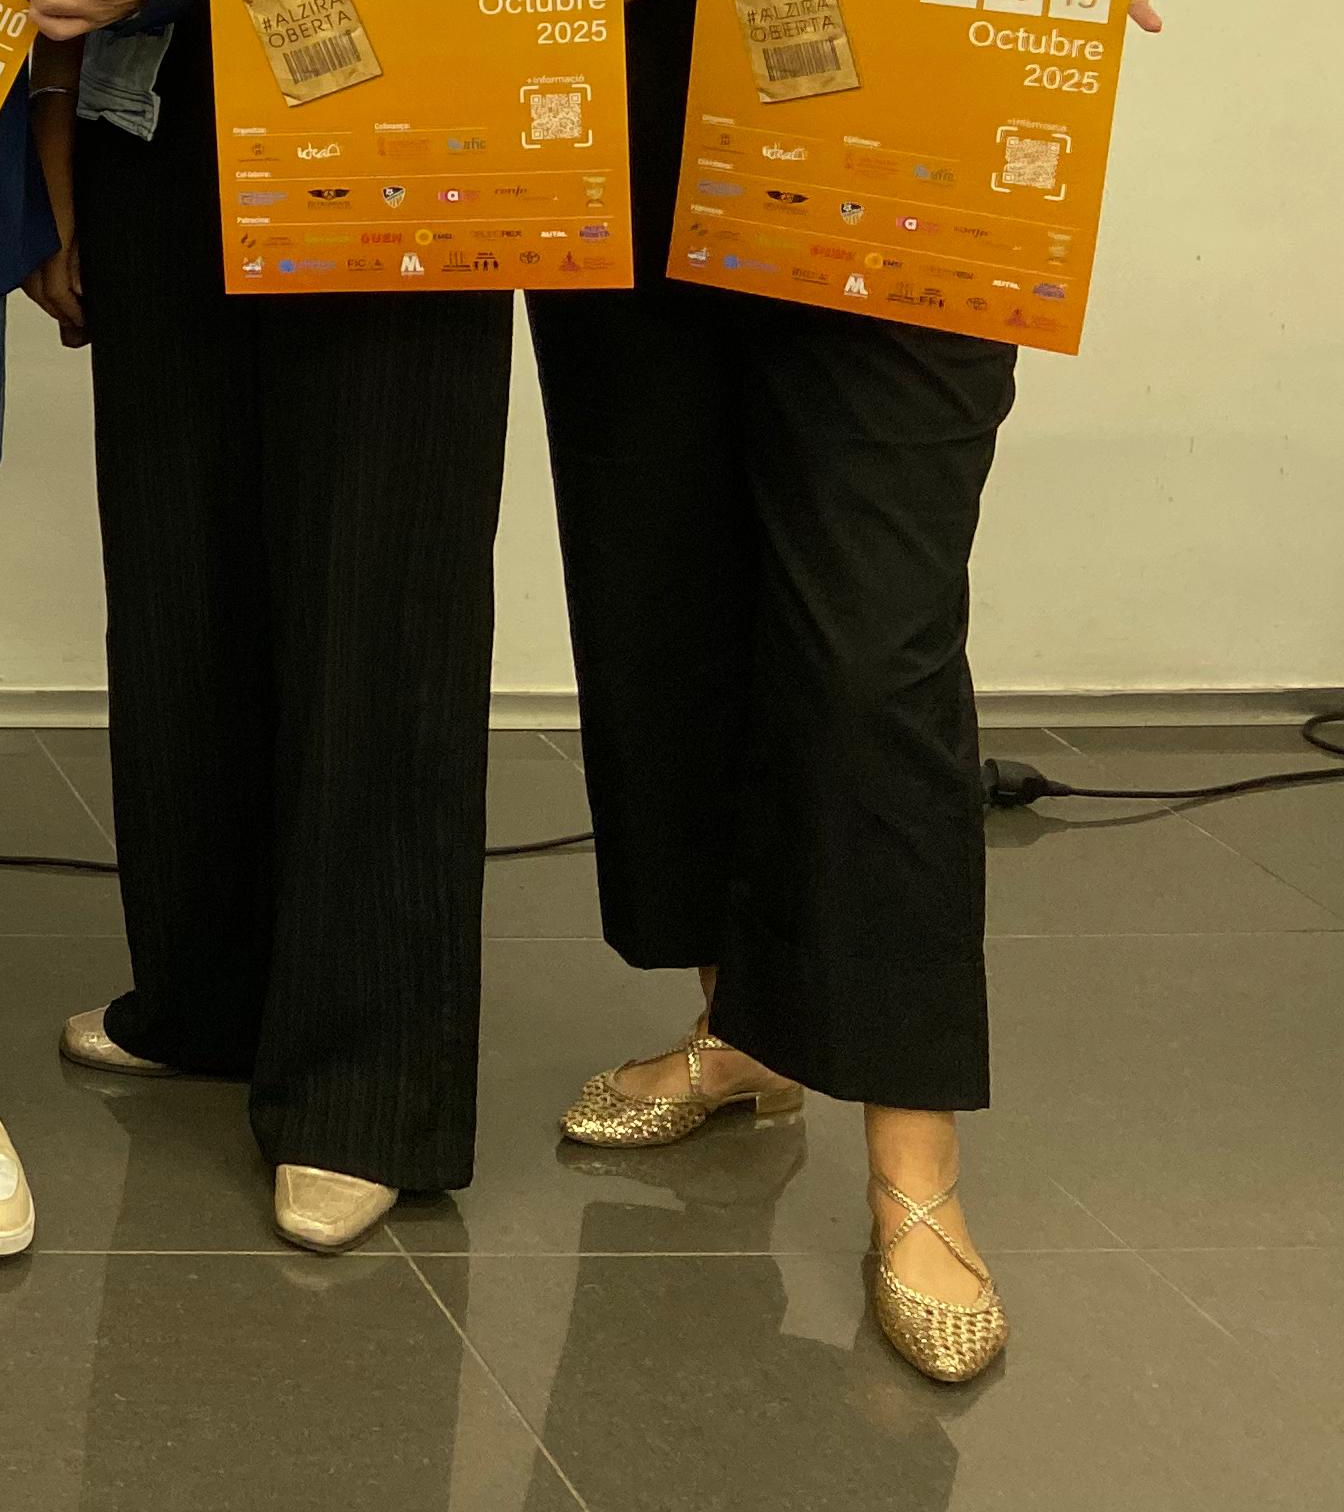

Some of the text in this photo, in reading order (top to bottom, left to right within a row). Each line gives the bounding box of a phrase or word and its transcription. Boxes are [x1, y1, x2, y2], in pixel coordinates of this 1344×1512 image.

[268, 11, 351, 49] OBERTA
[537, 20, 606, 44] 2025
[750, 14, 837, 43] OBERTA
[968, 21, 1104, 61] Octubre
[1024, 65, 1099, 95] 2025
